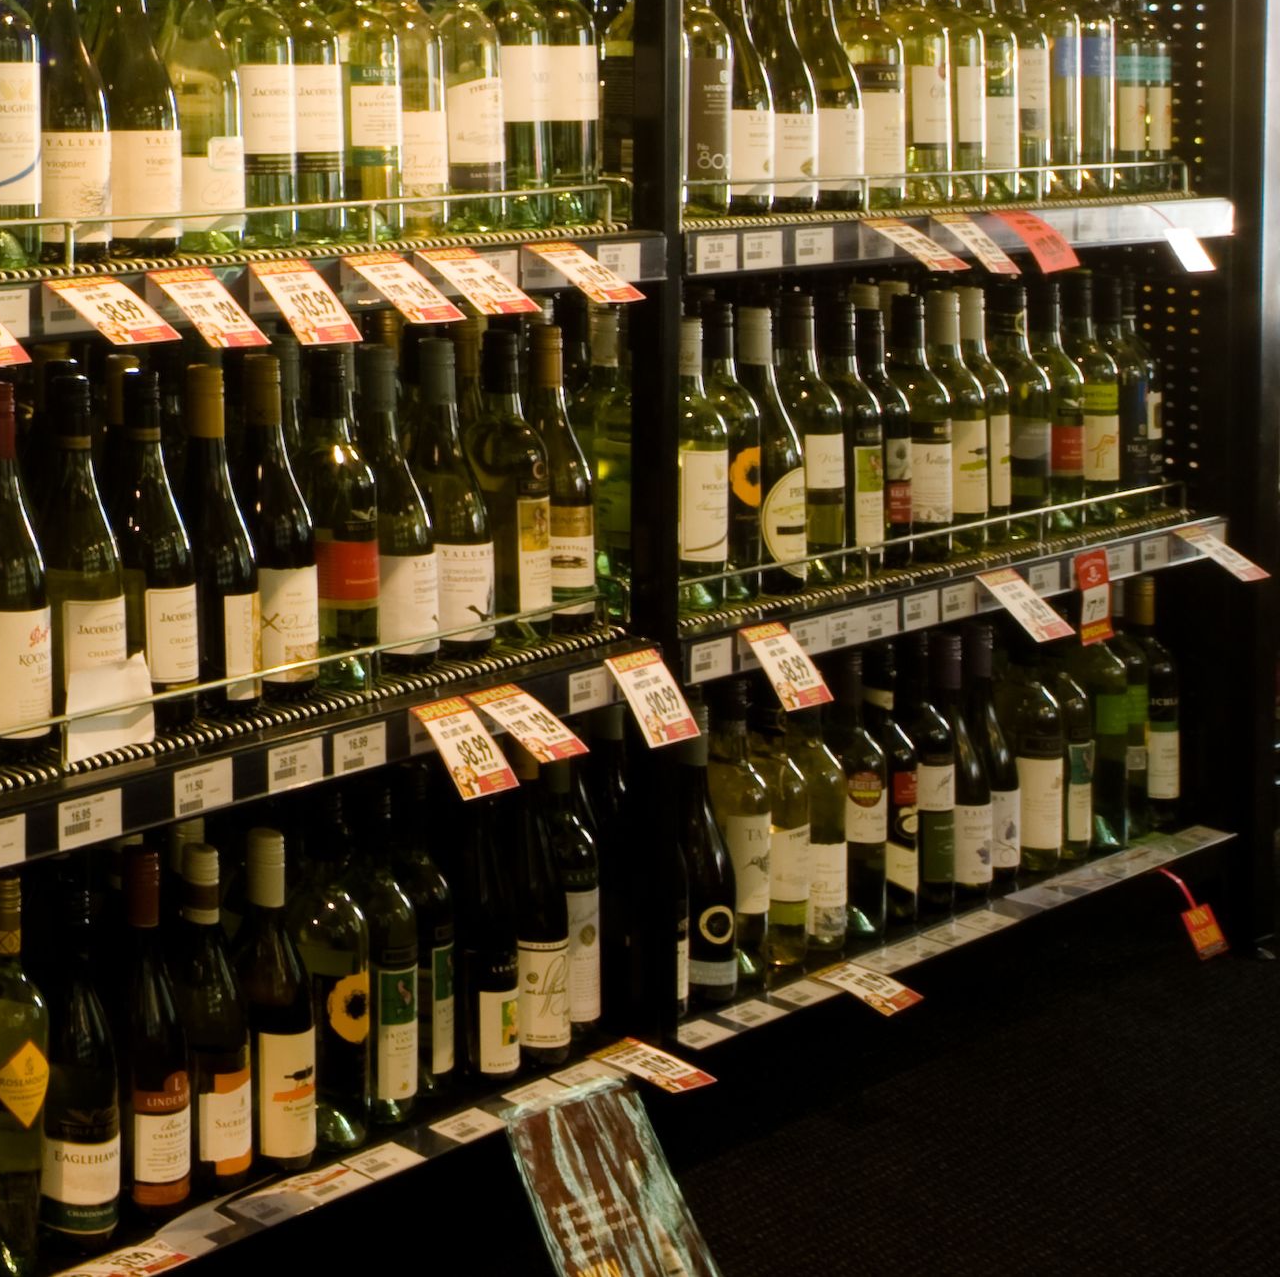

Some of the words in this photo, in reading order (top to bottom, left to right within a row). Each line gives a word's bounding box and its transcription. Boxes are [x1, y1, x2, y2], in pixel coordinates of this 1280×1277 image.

[96, 299, 147, 322] $8.99
[289, 291, 337, 315] $13.99
[417, 698, 468, 720] SPECIAL
[644, 686, 680, 716] $10.99
[456, 734, 494, 766] $8.99
